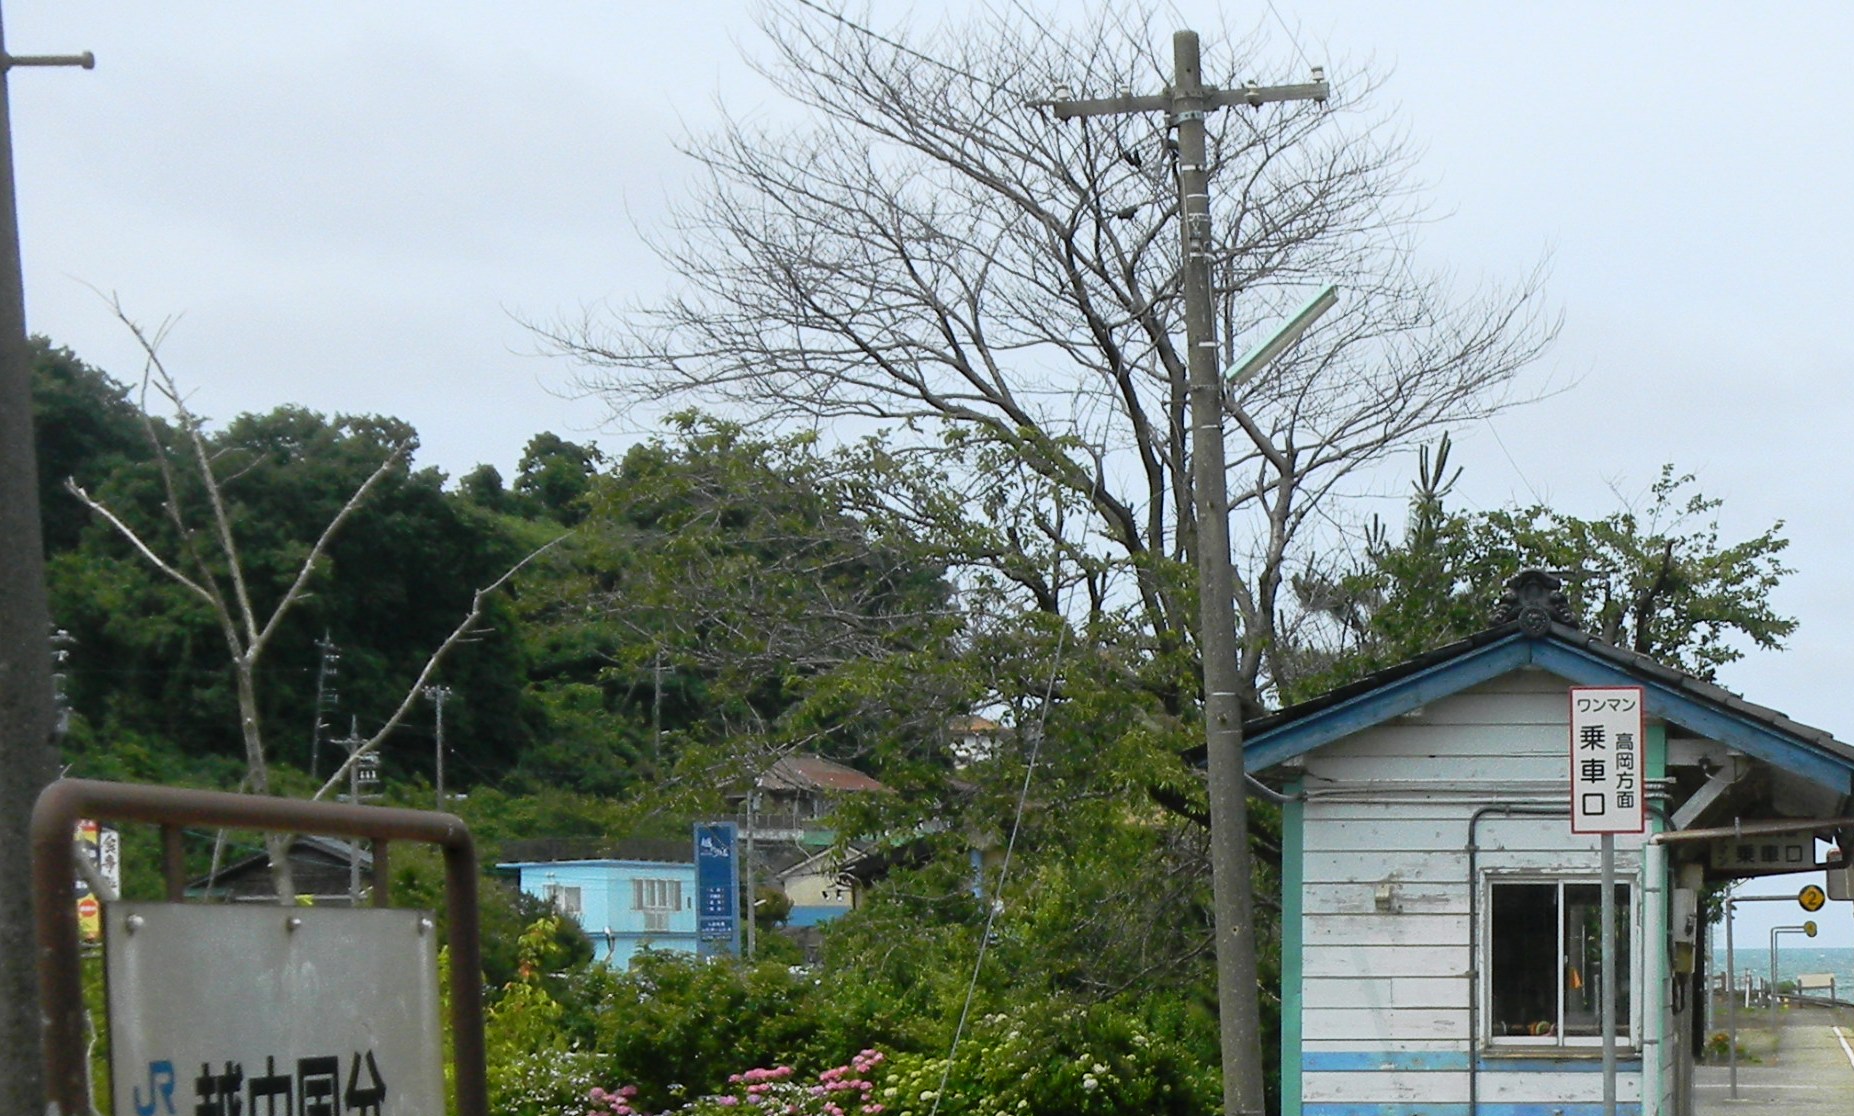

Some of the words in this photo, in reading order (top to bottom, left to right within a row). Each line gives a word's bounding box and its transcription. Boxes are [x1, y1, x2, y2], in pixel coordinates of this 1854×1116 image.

[1577, 698, 1636, 712] ワンマン
[1580, 724, 1606, 816] 乗車口
[1615, 732, 1634, 808] 高岡方面
[1736, 844, 1803, 863] 乗車口
[1807, 891, 1816, 905] 2
